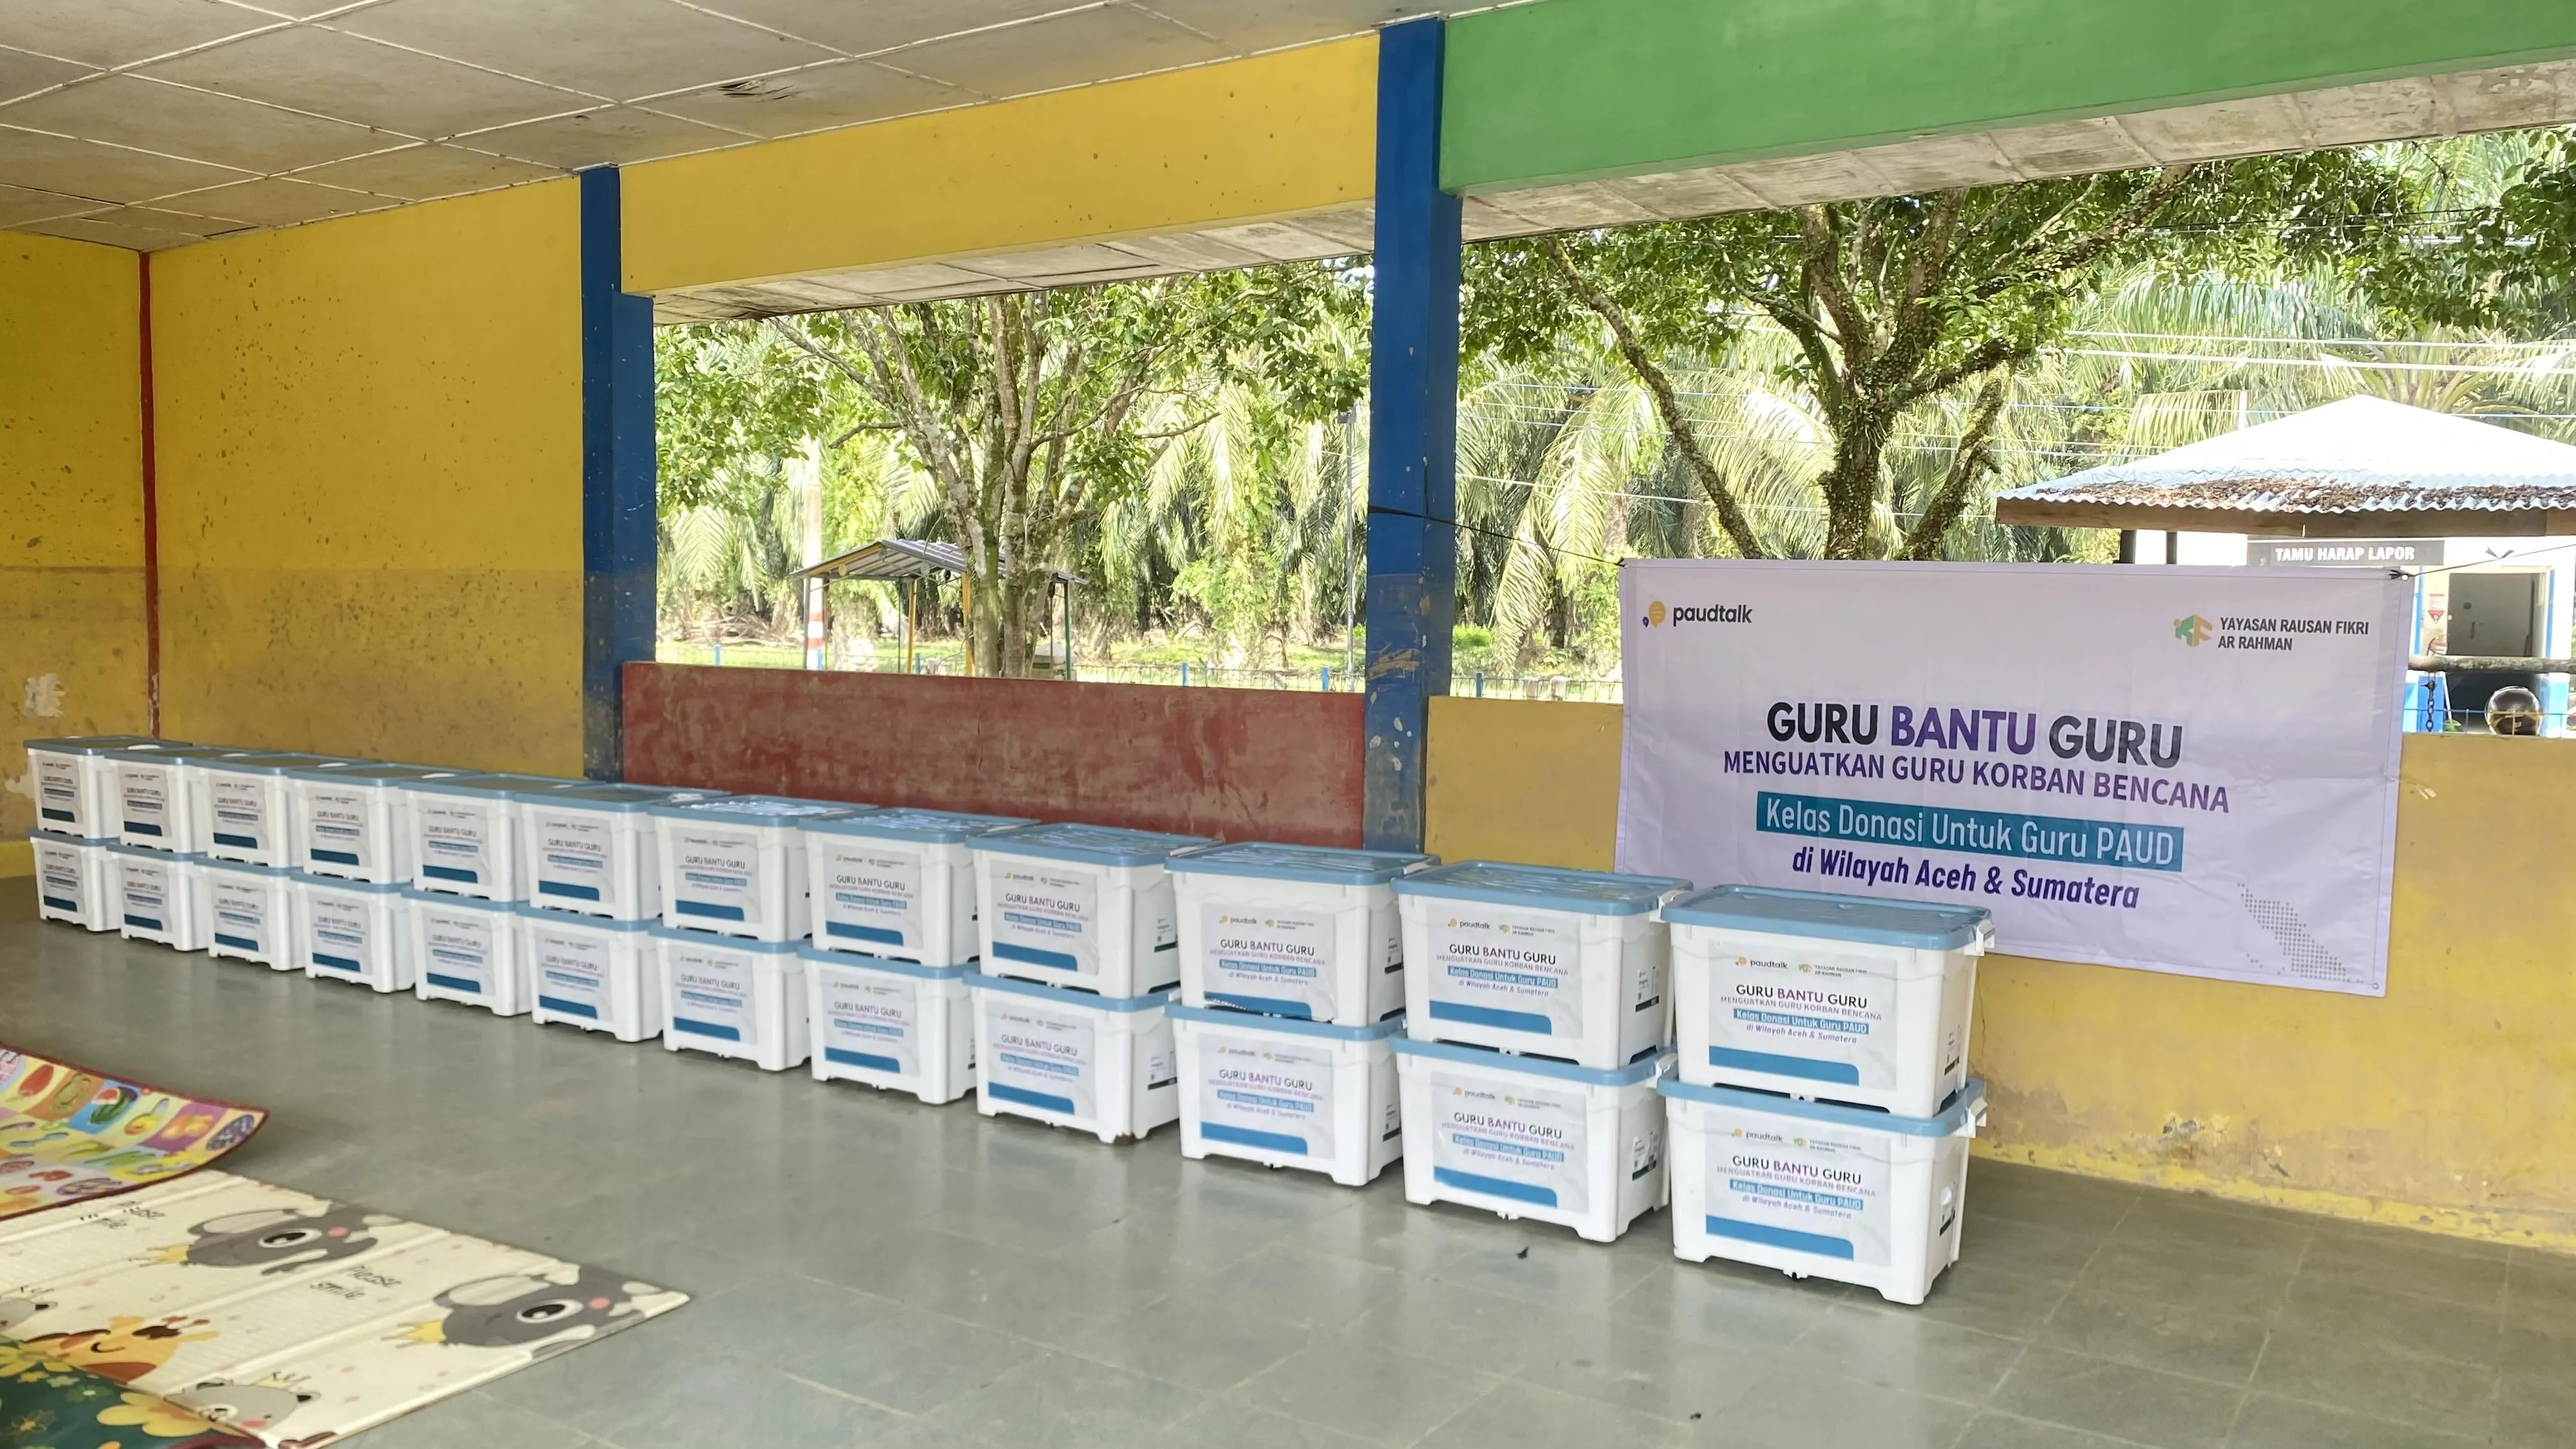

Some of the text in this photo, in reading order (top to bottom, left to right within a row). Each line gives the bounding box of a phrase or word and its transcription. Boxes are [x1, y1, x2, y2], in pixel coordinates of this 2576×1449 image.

[2275, 546, 2414, 561] TAMU HARAP LAPOR
[1673, 604, 1752, 627] paudtalk
[2220, 617, 2369, 634] YAYASAN RAUSAN FIKRI
[2218, 636, 2292, 650] AR RAHMAN
[1767, 702, 2182, 769] GURU BANTU GURU
[1724, 751, 2229, 813] MENGUATKAN GURU KORBAN BENCANA
[1766, 797, 2174, 865] Kelas Donasi Untuk Guru PAUD
[1792, 847, 2139, 909] di Wilayah Aceh & Sumatera
[1006, 893, 1080, 912] GURU BANTU GURU
[1220, 939, 1314, 955] GURU BANTU GURU
[1449, 944, 1556, 964] GURU BANTU GURU
[1437, 955, 1482, 963] MENGUATKAN
[1505, 961, 1533, 970] KORBAN
[1535, 965, 1567, 975] BENCANA
[1751, 960, 1787, 969] paudtalk
[1450, 967, 1556, 987] Kelas Donasi Untuk Guru PAUD
[1466, 980, 1490, 990] Wilayah
[1517, 987, 1548, 997] Sumatera
[1736, 985, 1867, 1008] GURU BANTU GURU
[1721, 997, 1882, 1020] MENGUATKAN GURU KORBAN BENCANA
[1736, 1010, 1866, 1033] Kelas Donasi Untuk Guru PAUD
[1756, 1025, 1785, 1036] Wilayah
[1788, 1029, 1807, 1037] Aceh
[1818, 1032, 1857, 1043] Sumatera
[1219, 1069, 1312, 1090] GURU BANTU GURU
[1454, 1112, 1561, 1138] GURU BANTU GURU
[1746, 1131, 1782, 1142] paudtalk
[1733, 1155, 1861, 1184] GURU BANTU GURU
[1717, 1167, 1875, 1197] MENGUATKAN GURU KORBAN BENCANA
